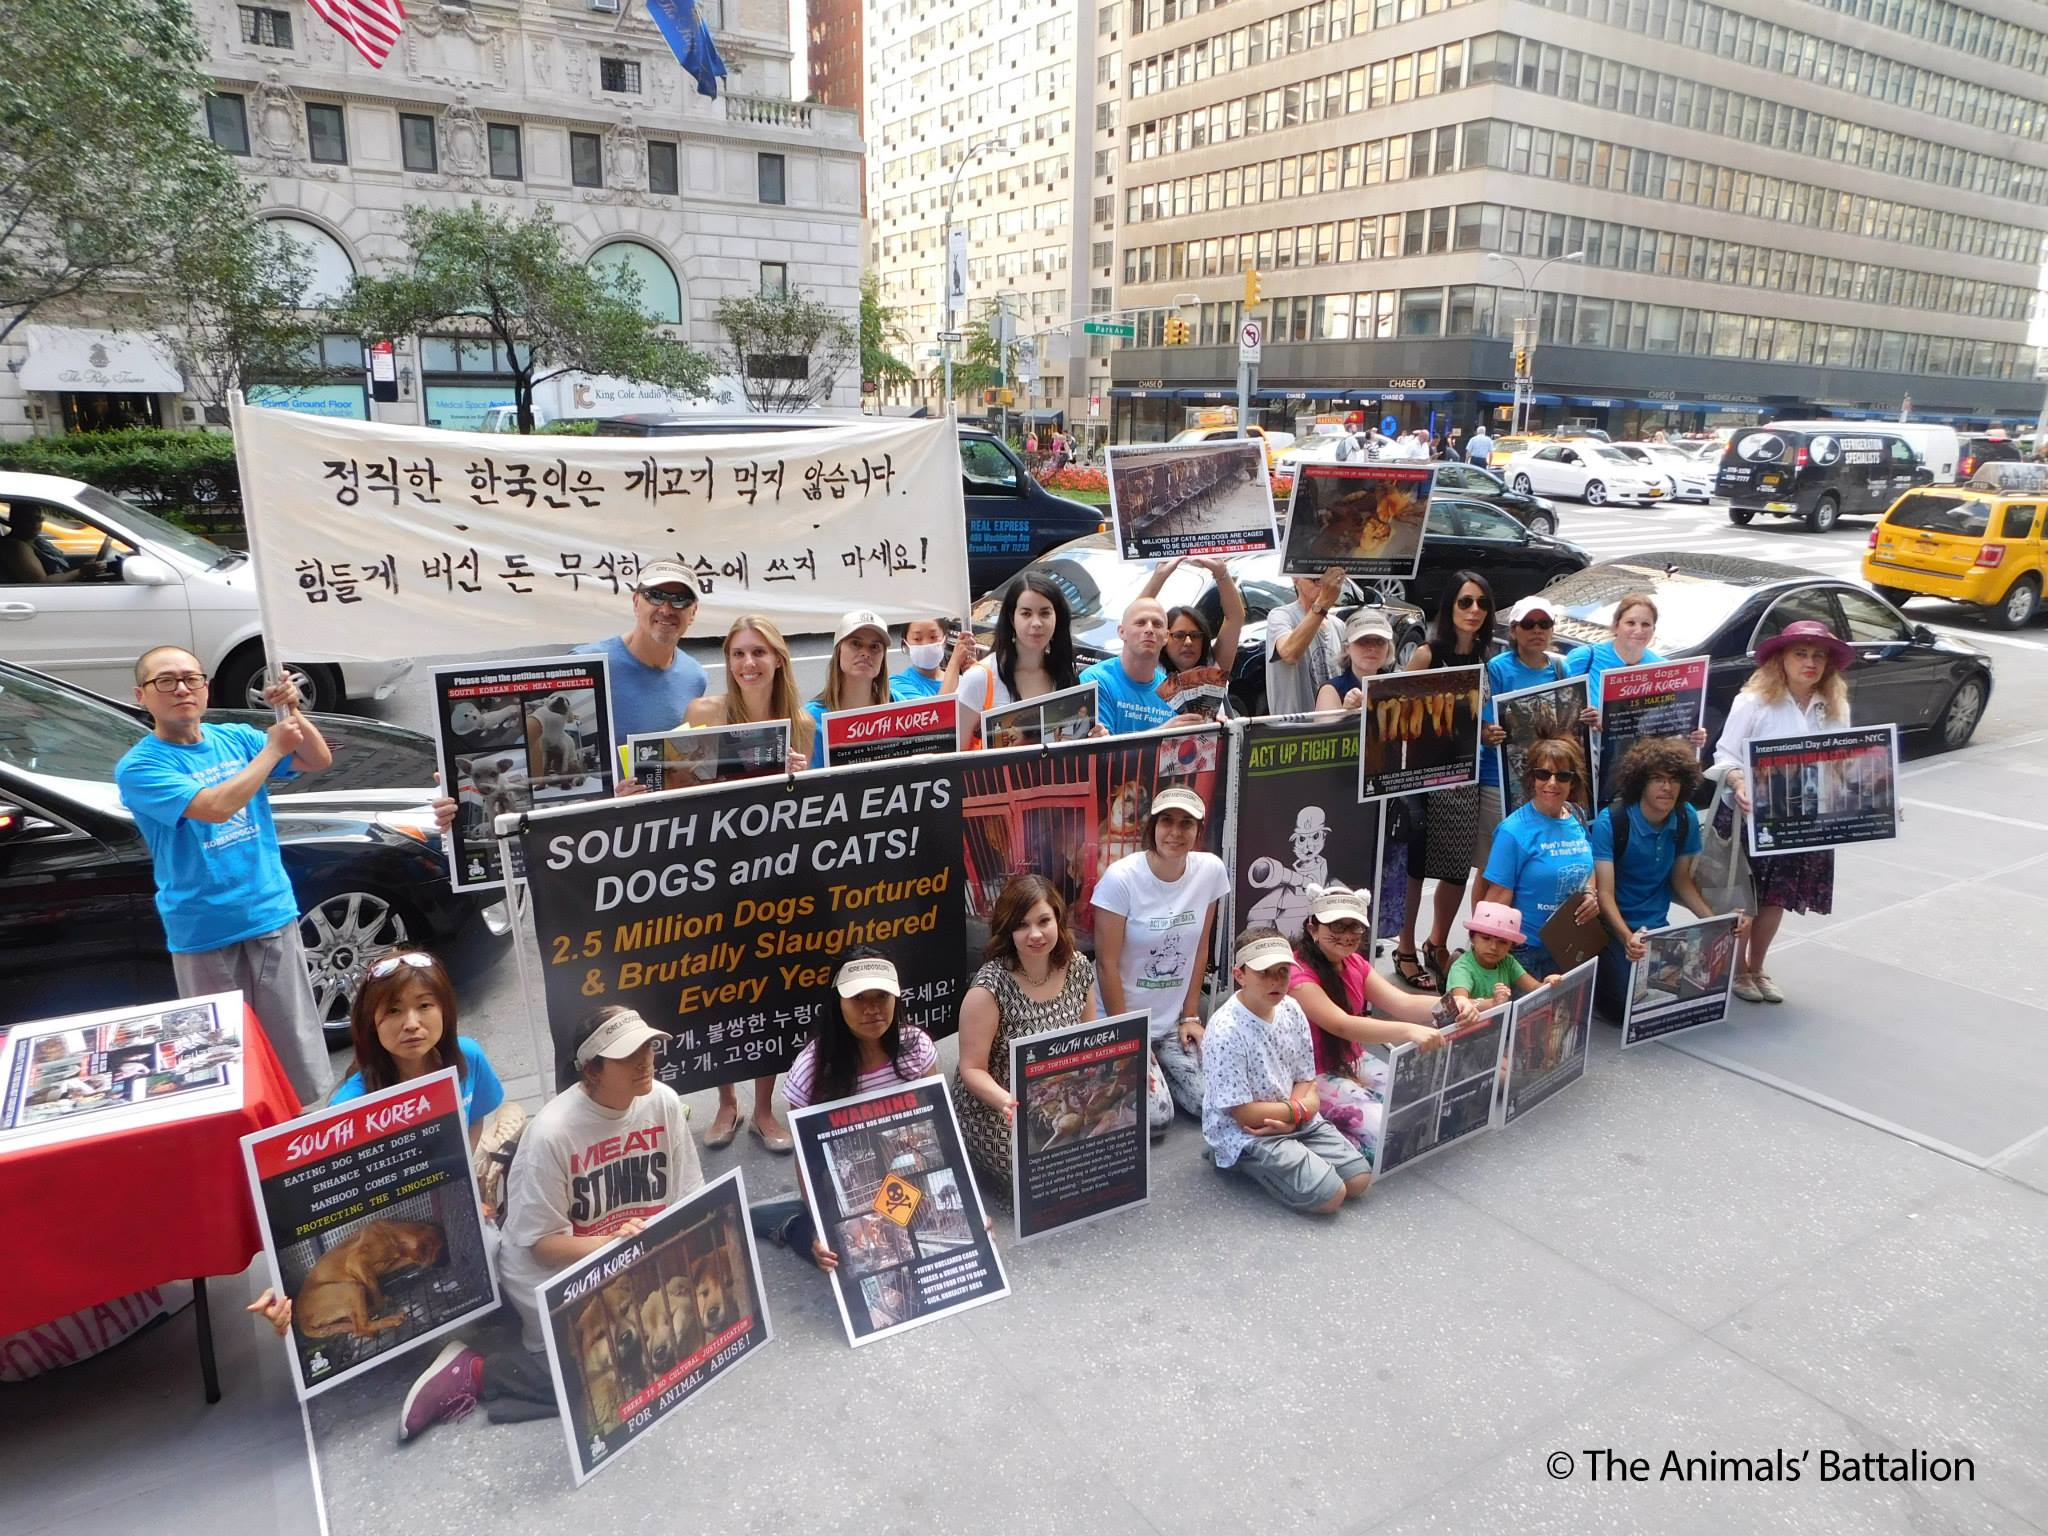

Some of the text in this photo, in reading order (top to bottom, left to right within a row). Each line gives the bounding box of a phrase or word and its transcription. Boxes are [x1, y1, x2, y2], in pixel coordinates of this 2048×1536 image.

[1095, 325, 1113, 334] Park
[594, 388, 614, 401] King
[617, 389, 636, 400] Cole
[637, 388, 661, 400] Audio
[1138, 380, 1157, 389] CHASE
[1389, 379, 1417, 388] CHASE
[261, 399, 352, 409] Prime Ground Floor
[1845, 452, 1880, 464] SPECIALISTS
[322, 453, 907, 509] 정직한 한국인은 개고기 먹지 않습니다.
[970, 519, 1030, 532] REAL EXPRESS
[1141, 536, 1170, 545] MILLIONS
[1180, 534, 1196, 543] CATS
[1197, 533, 1211, 541] AND
[1211, 532, 1228, 540] DOGS
[1242, 530, 1264, 538] CAGED
[1148, 549, 1188, 558] AND VIOLENT
[1171, 542, 1180, 550] BE
[1181, 539, 1216, 549] SUBJECTED
[1226, 537, 1247, 545] CRUEL
[295, 553, 400, 605] 힘들게
[422, 547, 482, 593] 버신
[498, 553, 536, 593] 돈
[763, 547, 816, 583] 쓰지
[840, 536, 928, 579] 마세요!
[449, 678, 594, 698] SOUTH KOREAN DOG MEAT CRUELTY!
[453, 667, 587, 686] Please sign the petitions against the
[1609, 665, 1700, 685] Eating dogs in
[1619, 677, 1689, 697] SOUTH KOREA
[846, 709, 939, 739] SOUTH KOREA
[1135, 704, 1173, 717] Best Friend
[837, 750, 852, 758] Cats
[893, 749, 910, 757] while
[1249, 736, 1360, 768] ACT UP FIGHT BA
[1755, 733, 1886, 754] International Day of Action NYC
[545, 813, 698, 871] SOUTH
[708, 792, 850, 844] KOREA
[858, 778, 952, 821] EATS
[594, 825, 920, 913] DOGS and CATS!
[551, 866, 951, 965] 2.5 Million Dogs Tortured
[580, 905, 938, 998] & Brutally Slaughtered
[676, 963, 830, 1015] Every Yea
[675, 1003, 823, 1052] 개, 불쌍한 누렁
[1047, 1028, 1120, 1056] SOUTH KOREA!
[692, 1037, 783, 1074] 개, 고양이
[1030, 1064, 1046, 1073] STOP
[1047, 1057, 1080, 1069] TORTURING
[828, 1089, 918, 1129] WARNING
[285, 1094, 432, 1162] SOUTH KOREA
[816, 1132, 831, 1141] HOW
[831, 1126, 848, 1137] CLEAN
[848, 1125, 855, 1133] IS
[855, 1123, 865, 1131] THE
[892, 1113, 902, 1122] YOU
[902, 1110, 913, 1118] ARE
[283, 1122, 442, 1189] EATING DOG MEAT DOES NOT
[570, 1125, 665, 1175] MEAT
[311, 1147, 424, 1194] ENHANCE VIRILITY.
[310, 1160, 430, 1214] MANHOOD COMES FROM
[569, 1151, 667, 1221] STINKS
[295, 1171, 451, 1236] PROTECTING THE INNOCENT.
[611, 1208, 645, 1220] ANIMALS
[563, 1241, 645, 1303] SOUTH KOREA!
[622, 1320, 749, 1416] THERE IS NO CULTURAL JUSTIFICATION
[626, 1334, 750, 1433] FOR ANIMAL ABUSE!
